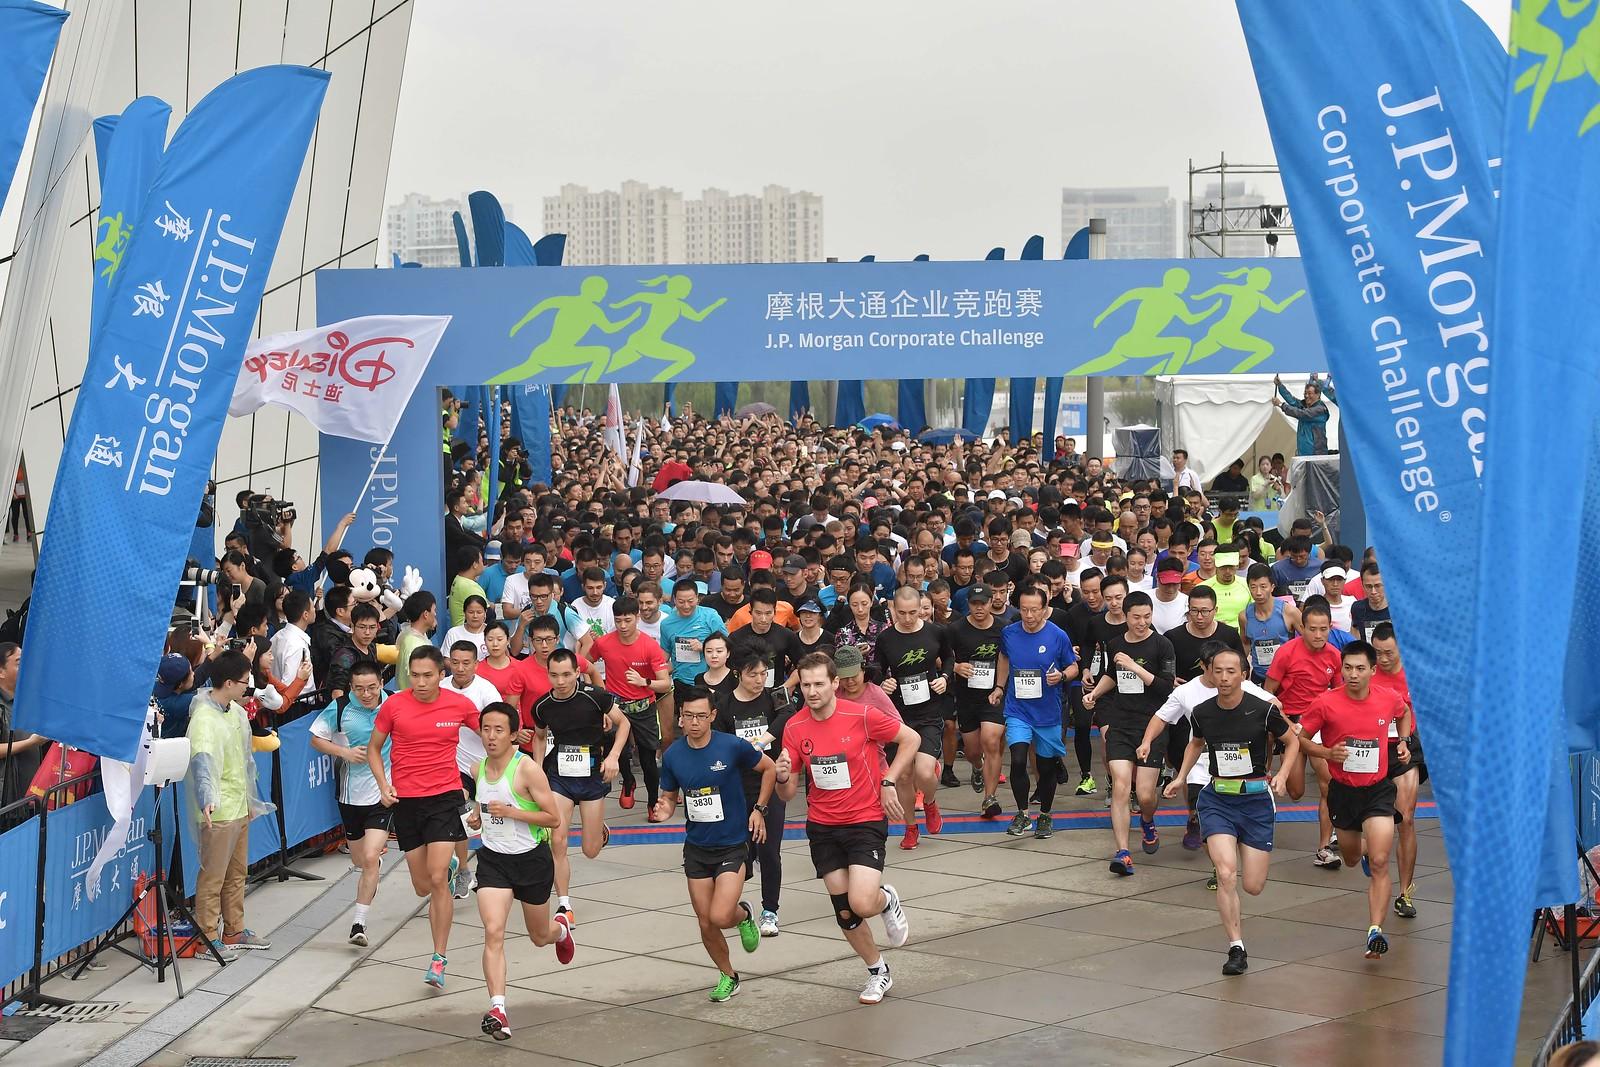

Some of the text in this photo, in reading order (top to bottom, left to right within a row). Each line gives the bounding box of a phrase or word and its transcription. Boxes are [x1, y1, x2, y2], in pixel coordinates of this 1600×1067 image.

[1317, 105, 1387, 304] Corporate
[765, 287, 1043, 321] 摩根大通企业竞跑赛
[765, 328, 1044, 351] J.P. Morgan Corporate Challenge
[138, 213, 257, 496] J.P.Morgan
[911, 683, 919, 691] 30
[744, 728, 762, 738] 2311
[565, 754, 583, 762] 2070
[1224, 752, 1242, 761] 3694
[1355, 750, 1370, 758] 417
[821, 765, 838, 775] 326
[692, 796, 713, 808] 3830
[490, 815, 504, 825] 353
